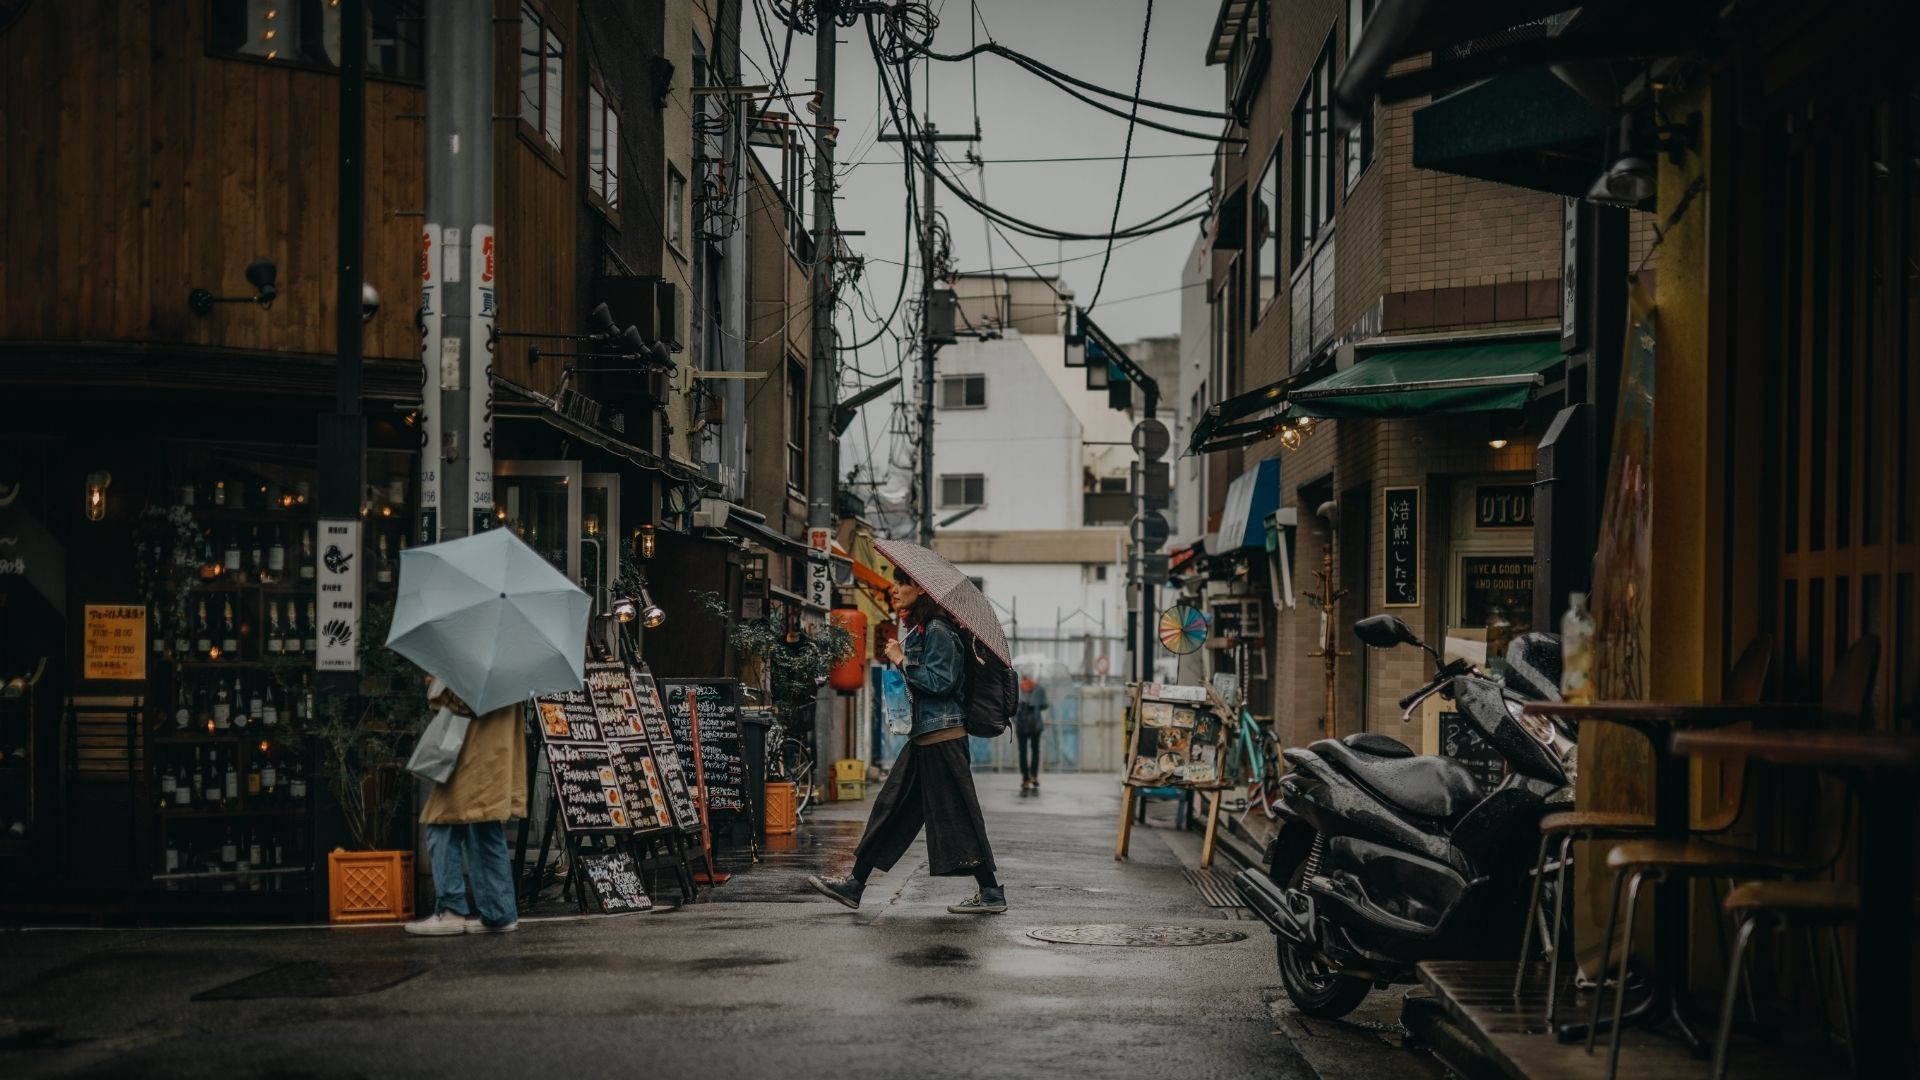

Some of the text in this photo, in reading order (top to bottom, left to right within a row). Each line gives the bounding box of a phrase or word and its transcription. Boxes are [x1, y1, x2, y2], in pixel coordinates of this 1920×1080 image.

[1491, 564, 1497, 575] A
[1499, 564, 1521, 575] GOOD
[1474, 579, 1533, 590] AND GOOD LIFE
